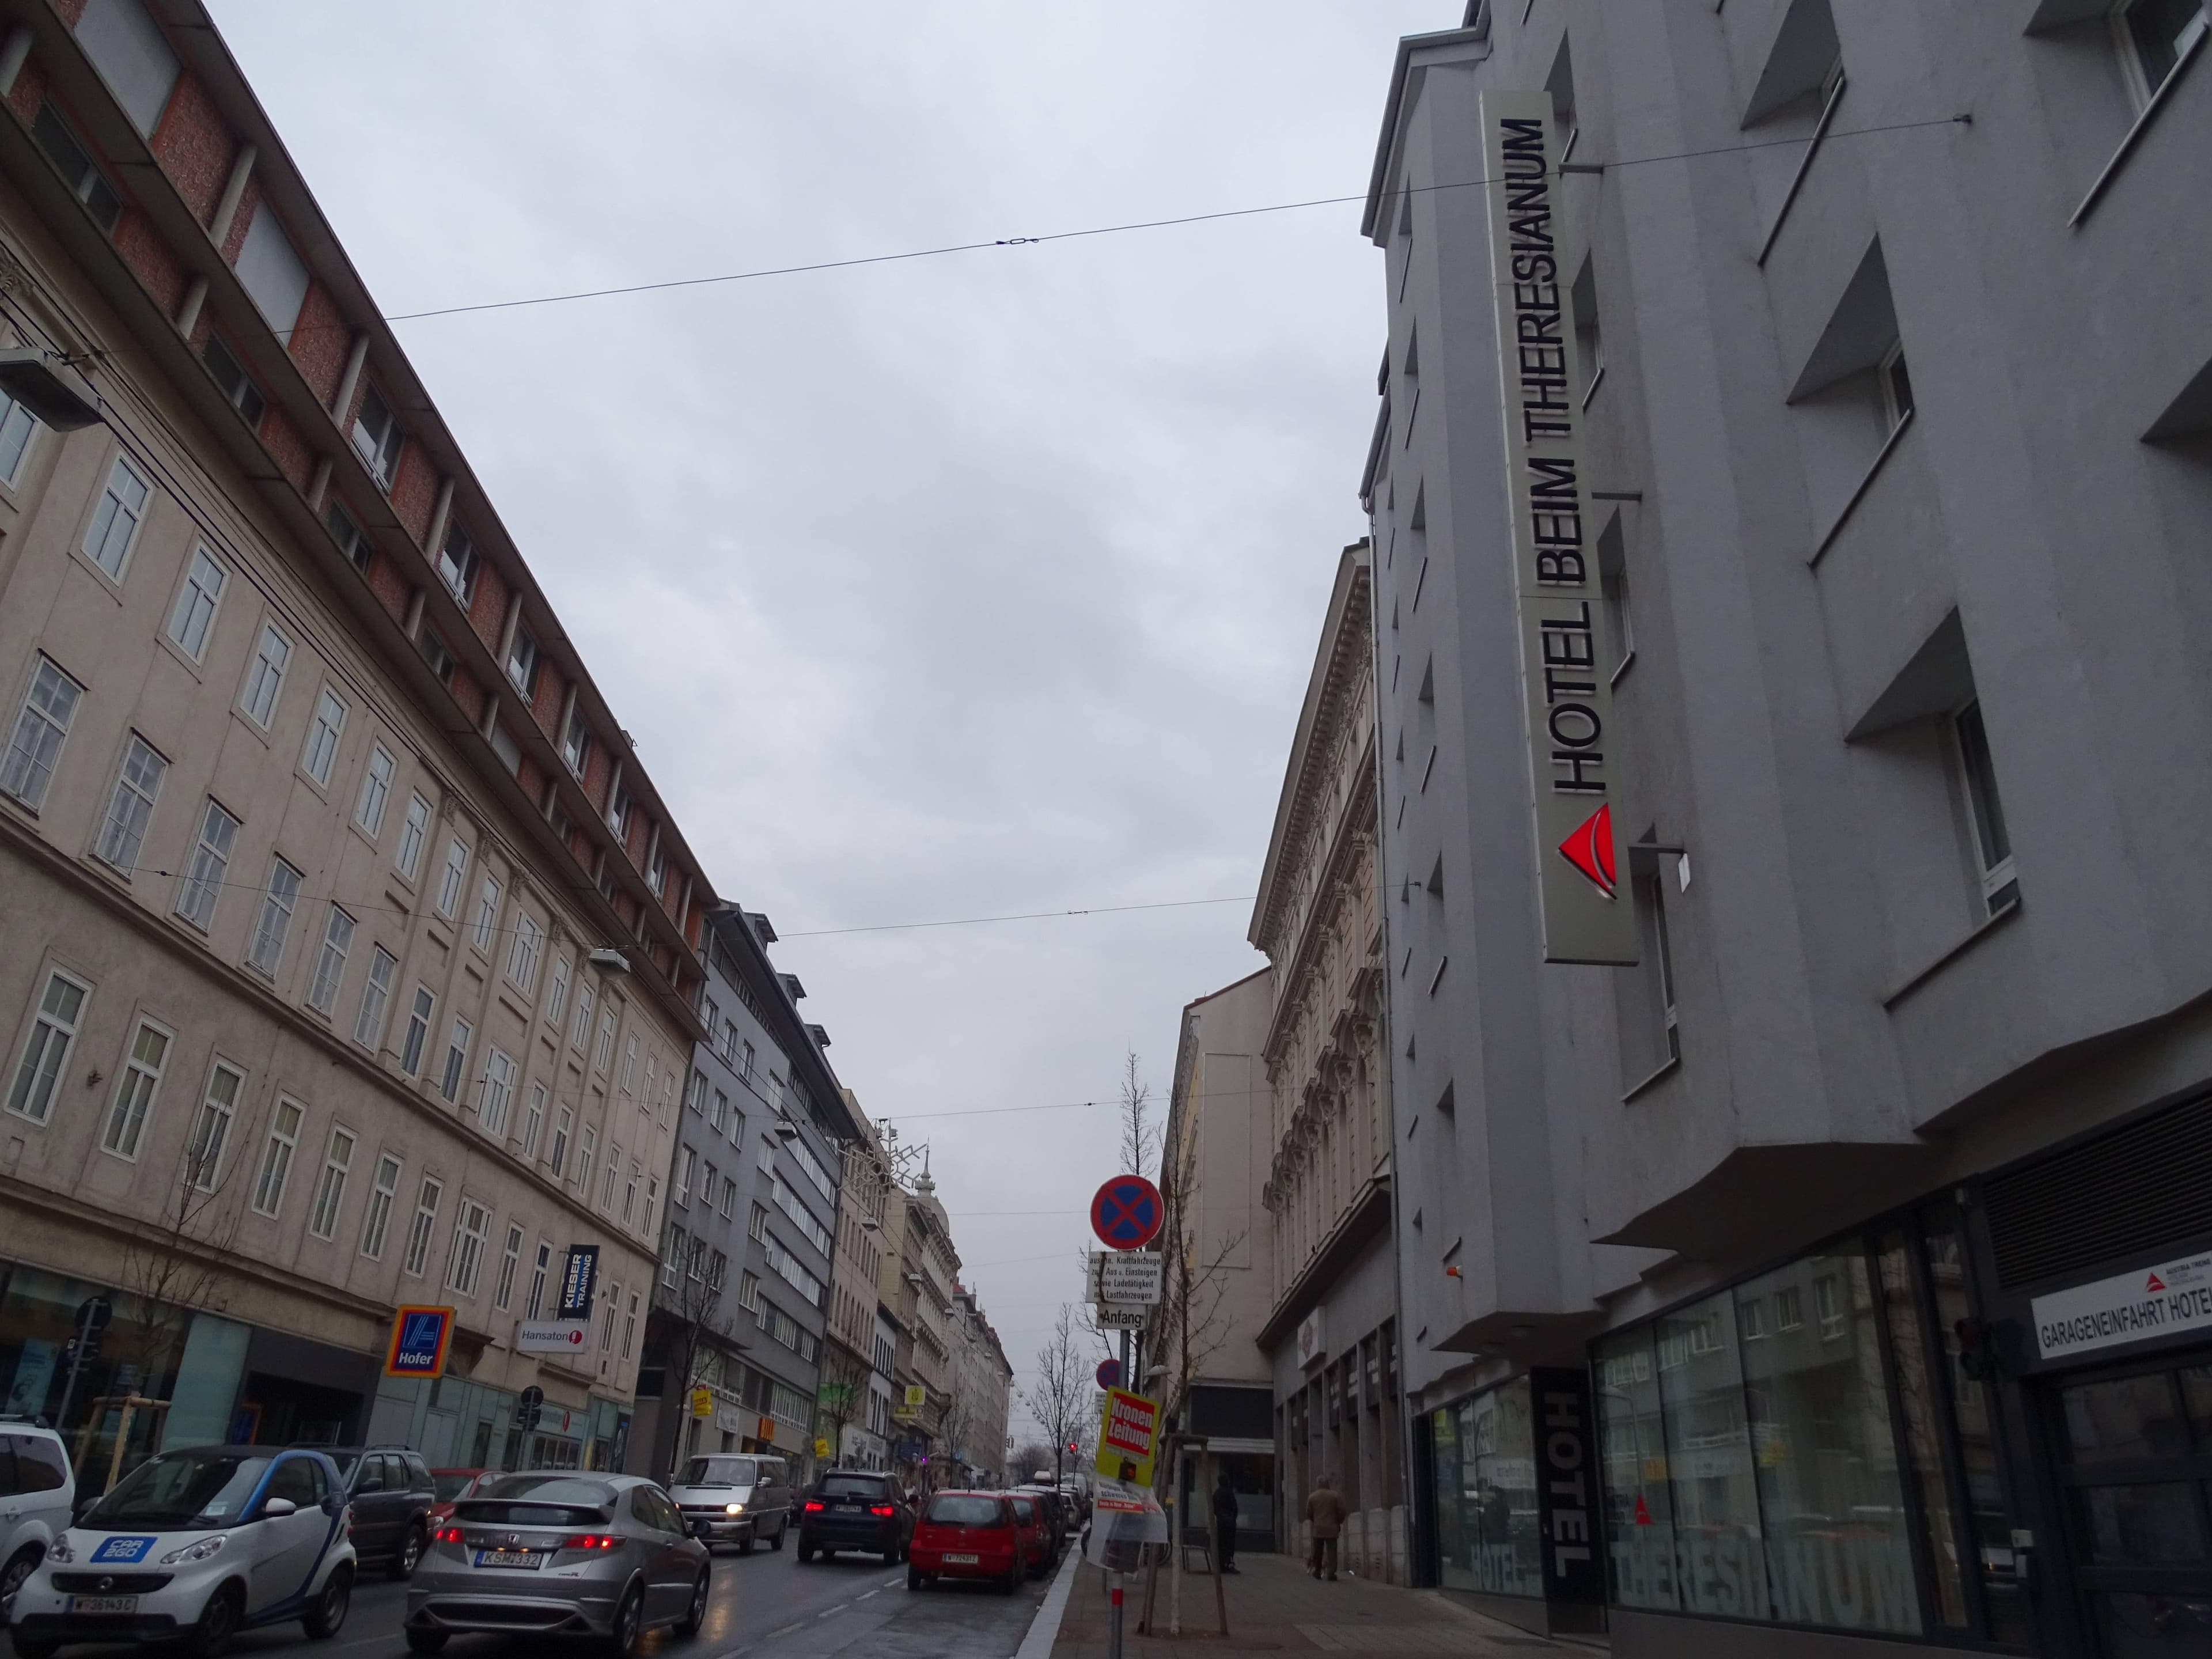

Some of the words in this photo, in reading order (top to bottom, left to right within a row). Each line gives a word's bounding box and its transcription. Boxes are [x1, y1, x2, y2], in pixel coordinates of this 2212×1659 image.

[1499, 118, 1571, 442] THERESIANUM
[1528, 457, 1586, 582] BEIM
[1540, 601, 1607, 791] HOTEL
[1106, 1267, 1117, 1275] Aus
[1125, 1267, 1157, 1278] Einsteigen
[1116, 1256, 1161, 1266] Kraftfahrzeuge
[565, 1253, 582, 1308] KIESER
[576, 1254, 592, 1308] TRAINING
[1114, 1278, 1154, 1289] Ladetätigkeit
[1106, 1290, 1153, 1301] Lastfahrzeugen
[1102, 1309, 1142, 1328] Anfang
[2041, 1297, 2166, 1348] GARAGENEINFAHRT
[521, 1330, 569, 1341] Hansaton
[398, 1352, 433, 1365] Hofer
[1111, 1396, 1154, 1429] Kronen
[1107, 1416, 1152, 1450] Zeitung
[1543, 1390, 1591, 1578] HOTEL
[102, 1548, 138, 1557] 2GO
[110, 1540, 145, 1548] CAR
